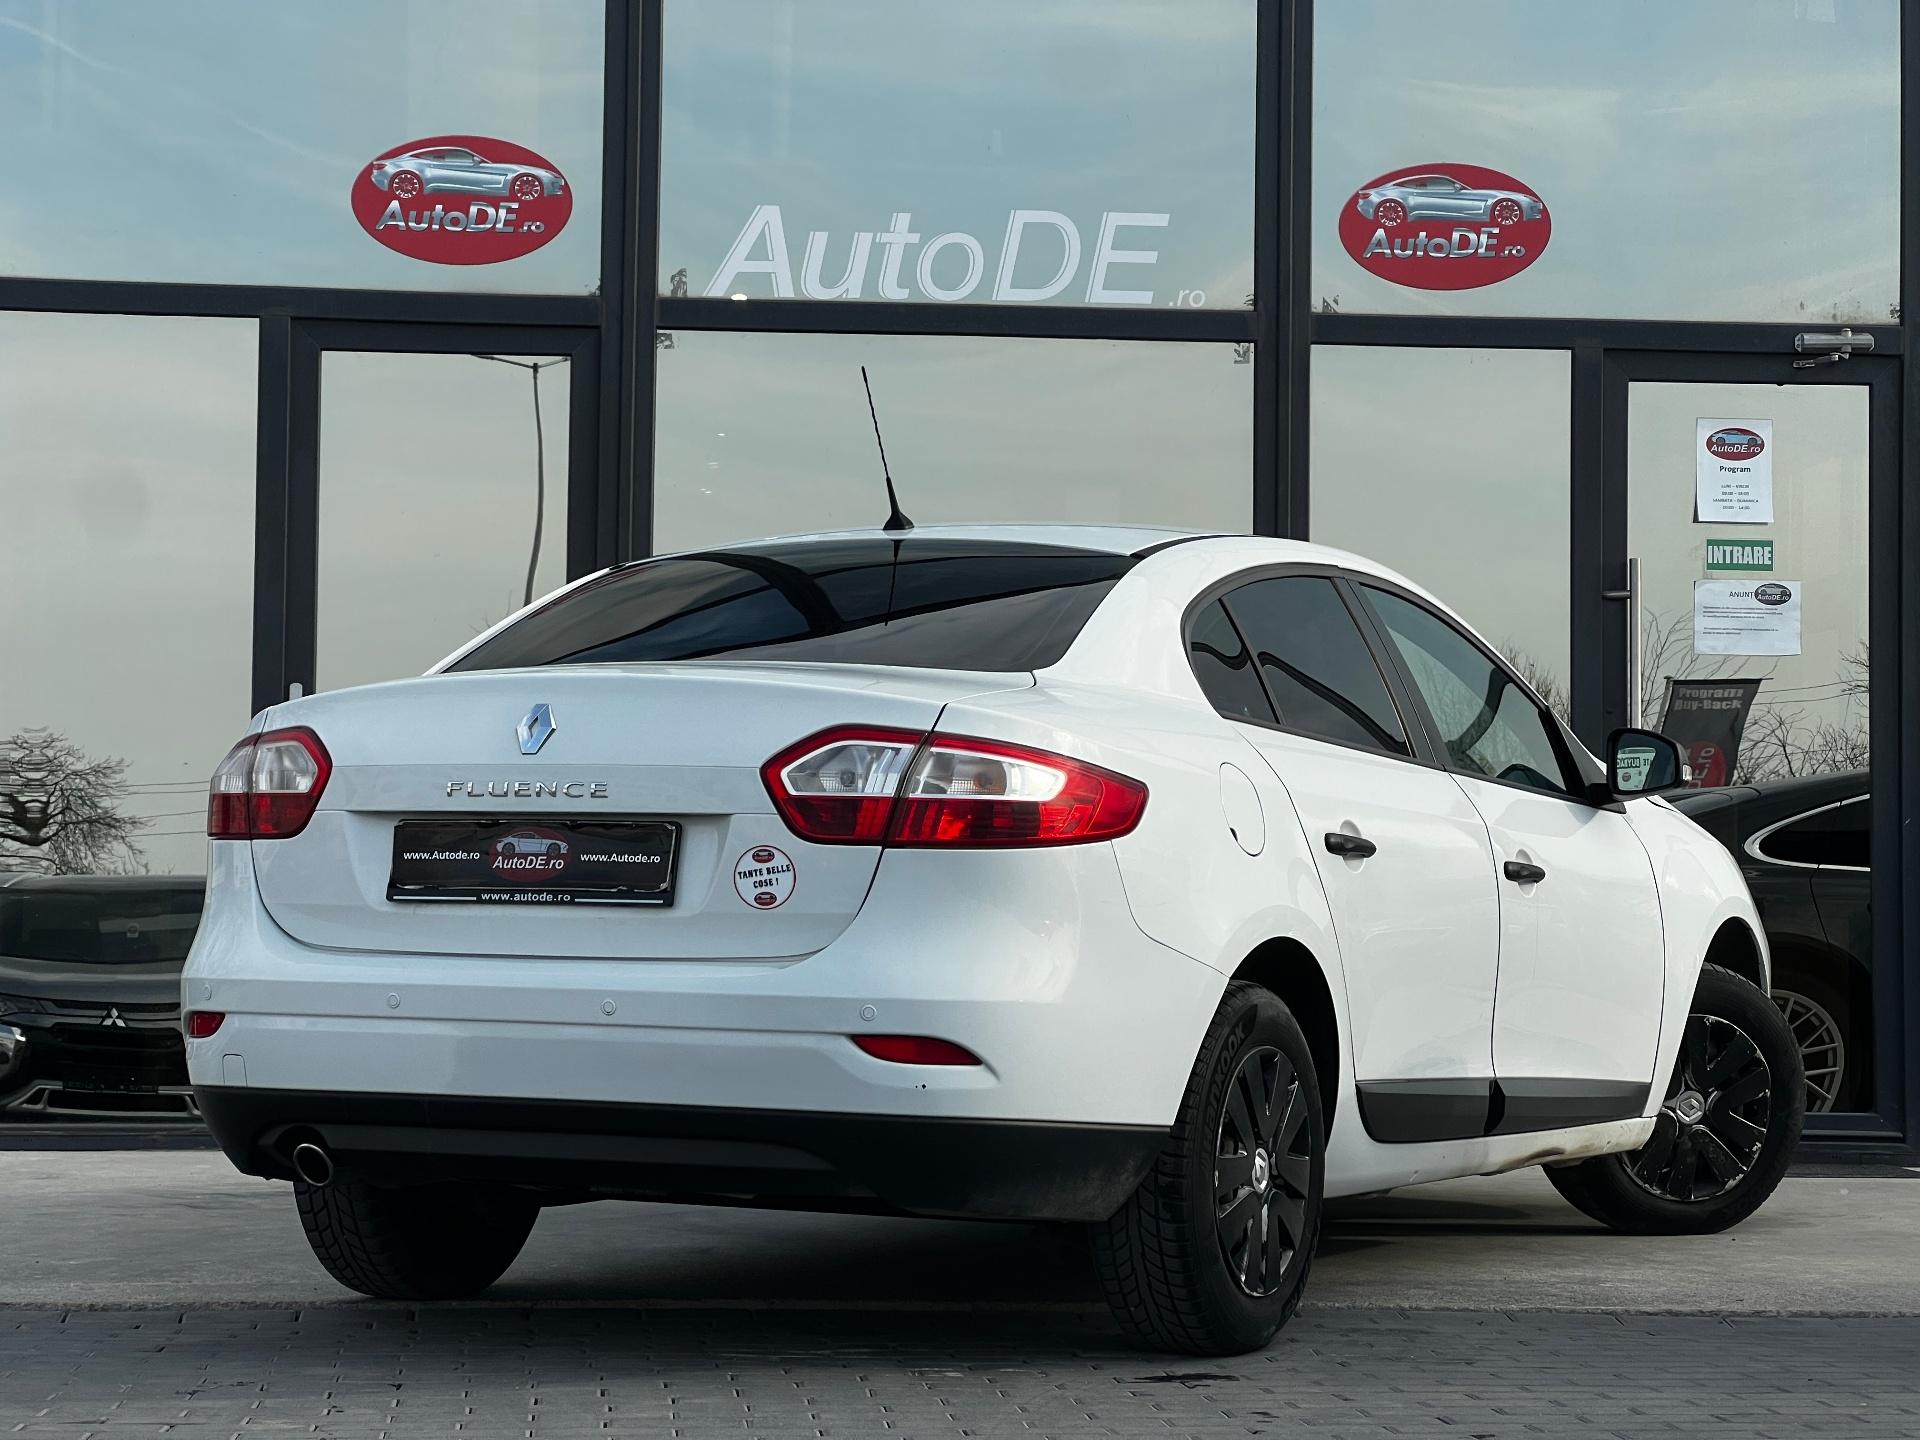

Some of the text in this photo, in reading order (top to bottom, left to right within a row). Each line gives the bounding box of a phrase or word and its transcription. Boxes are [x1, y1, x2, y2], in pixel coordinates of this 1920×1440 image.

[1710, 444, 1761, 453] AutoDE.ro
[1719, 465, 1751, 473] Program
[1707, 545, 1772, 565] INTRARE
[1678, 687, 1744, 698] Program
[1674, 699, 1743, 711] Buy-Back
[446, 781, 609, 799] FLUENCE
[403, 850, 480, 861] www.Autode.ro
[580, 852, 661, 864] www.Autode.ro
[492, 856, 565, 869] AutoDE.ro
[738, 864, 792, 880] TANTE BELLE
[753, 878, 773, 888] COSE
[481, 891, 571, 902] www.autode.ro
